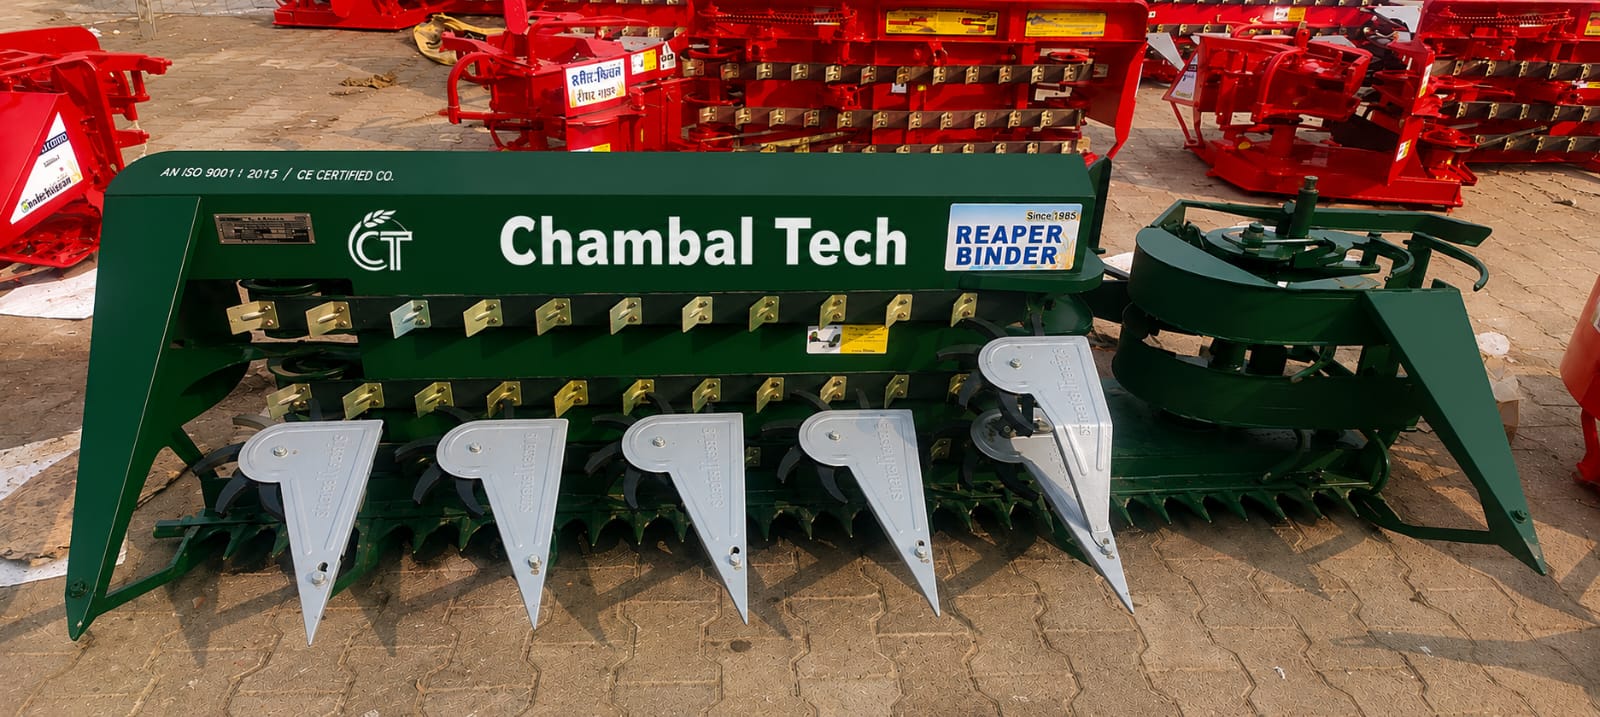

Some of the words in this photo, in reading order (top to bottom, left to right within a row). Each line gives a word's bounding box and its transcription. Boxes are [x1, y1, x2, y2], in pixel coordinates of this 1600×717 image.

[160, 167, 180, 177] AN
[181, 167, 202, 178] ISO
[205, 168, 234, 178] 9001
[247, 169, 279, 180] 2015
[297, 170, 314, 181] CE
[316, 170, 373, 181] CERTIFIED
[376, 171, 394, 182] CO.
[1027, 211, 1051, 220] Since
[1054, 211, 1077, 220] 1985
[499, 215, 753, 266] Chambal
[774, 216, 908, 266] Tech
[955, 225, 1062, 244] REAPER
[955, 246, 1057, 265] BINDER
